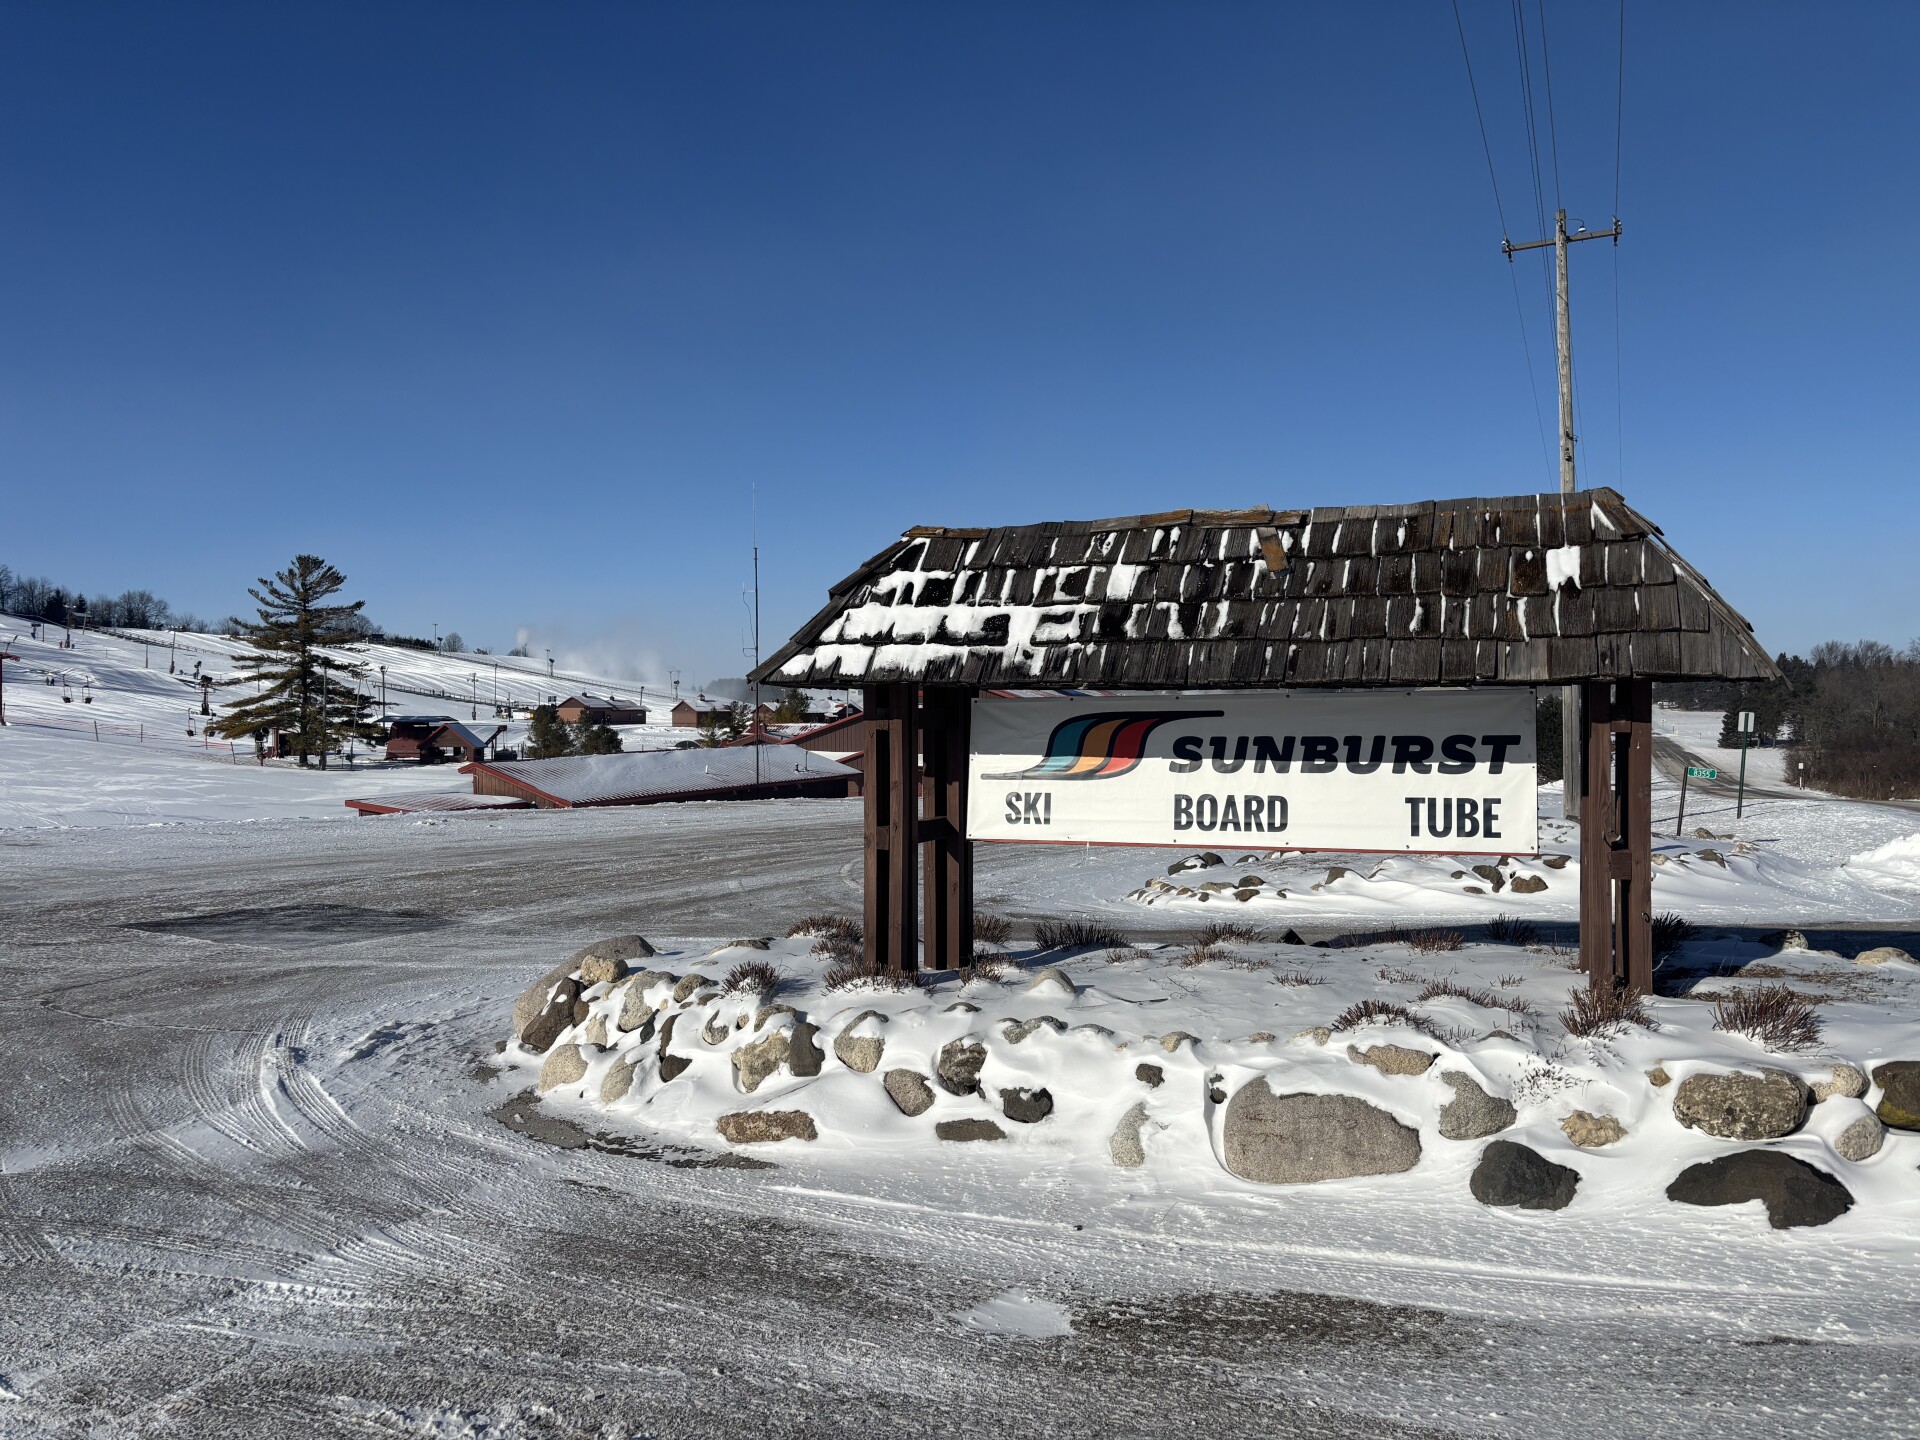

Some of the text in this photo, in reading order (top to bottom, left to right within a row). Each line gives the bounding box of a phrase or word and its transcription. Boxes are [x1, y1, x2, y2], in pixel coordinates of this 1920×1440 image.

[1169, 734, 1521, 775] SUNBURST
[1005, 792, 1502, 839] SKI BOARD TUBE
